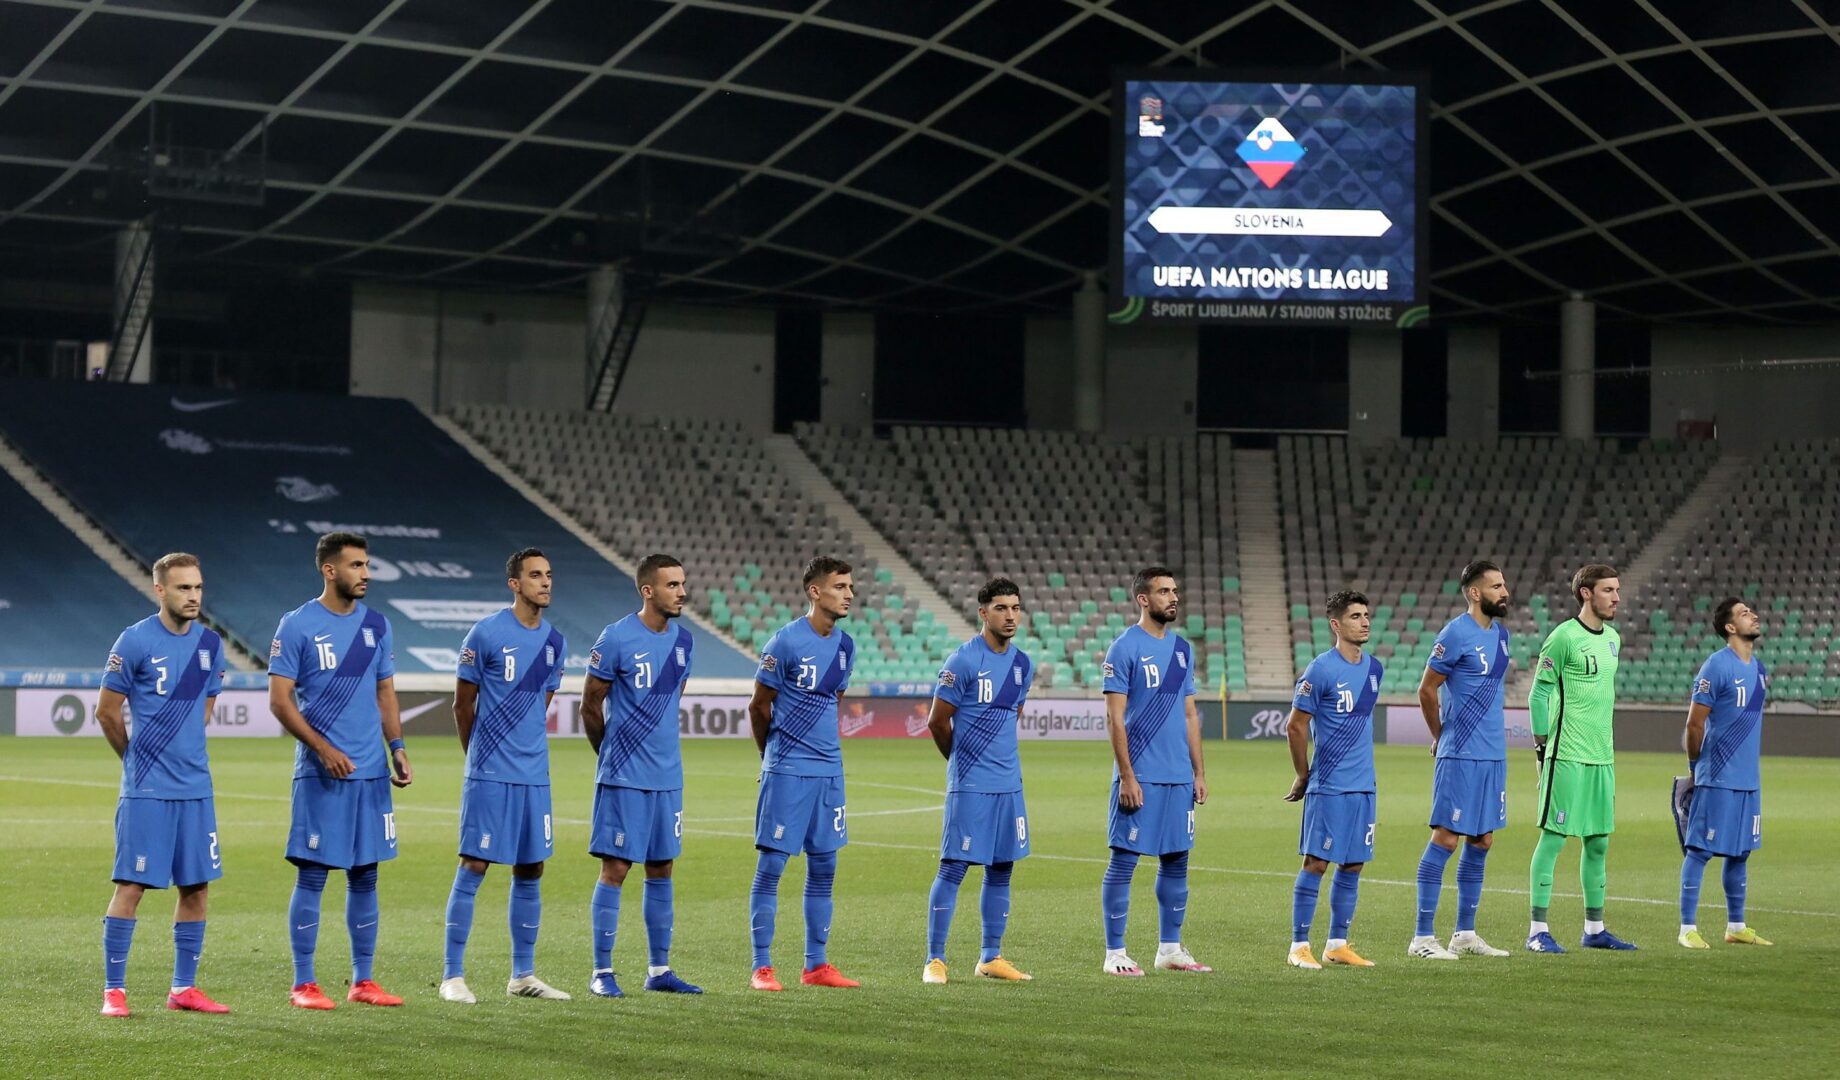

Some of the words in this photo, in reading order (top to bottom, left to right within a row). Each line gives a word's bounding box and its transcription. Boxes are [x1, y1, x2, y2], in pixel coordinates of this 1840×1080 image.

[1234, 214, 1304, 229] SLOVENIA
[1153, 266, 1206, 288] UEFA
[1211, 267, 1302, 289] NATIONS
[1308, 268, 1388, 291] LEAGUE
[1151, 302, 1194, 318] ŠPORT
[1198, 304, 1267, 319] LJUBLJANA
[1280, 304, 1335, 320] STADION
[1339, 305, 1392, 321] STOŽICE
[317, 643, 336, 671] 16
[504, 655, 516, 683] 8
[1480, 651, 1488, 676] 5
[1584, 655, 1598, 676] 13
[155, 667, 167, 696] 2
[634, 662, 652, 689] 21
[797, 664, 816, 690] 23
[1143, 664, 1160, 689] 19
[977, 679, 993, 704] 18
[1336, 690, 1354, 714] 20
[1736, 686, 1746, 708] 11
[211, 705, 249, 726] NLB
[1020, 708, 1105, 736] triglavzdra
[383, 813, 395, 840] 16
[543, 814, 551, 840] 8
[1016, 817, 1026, 840] 18
[1753, 815, 1760, 835] 11
[209, 832, 217, 860] 2
